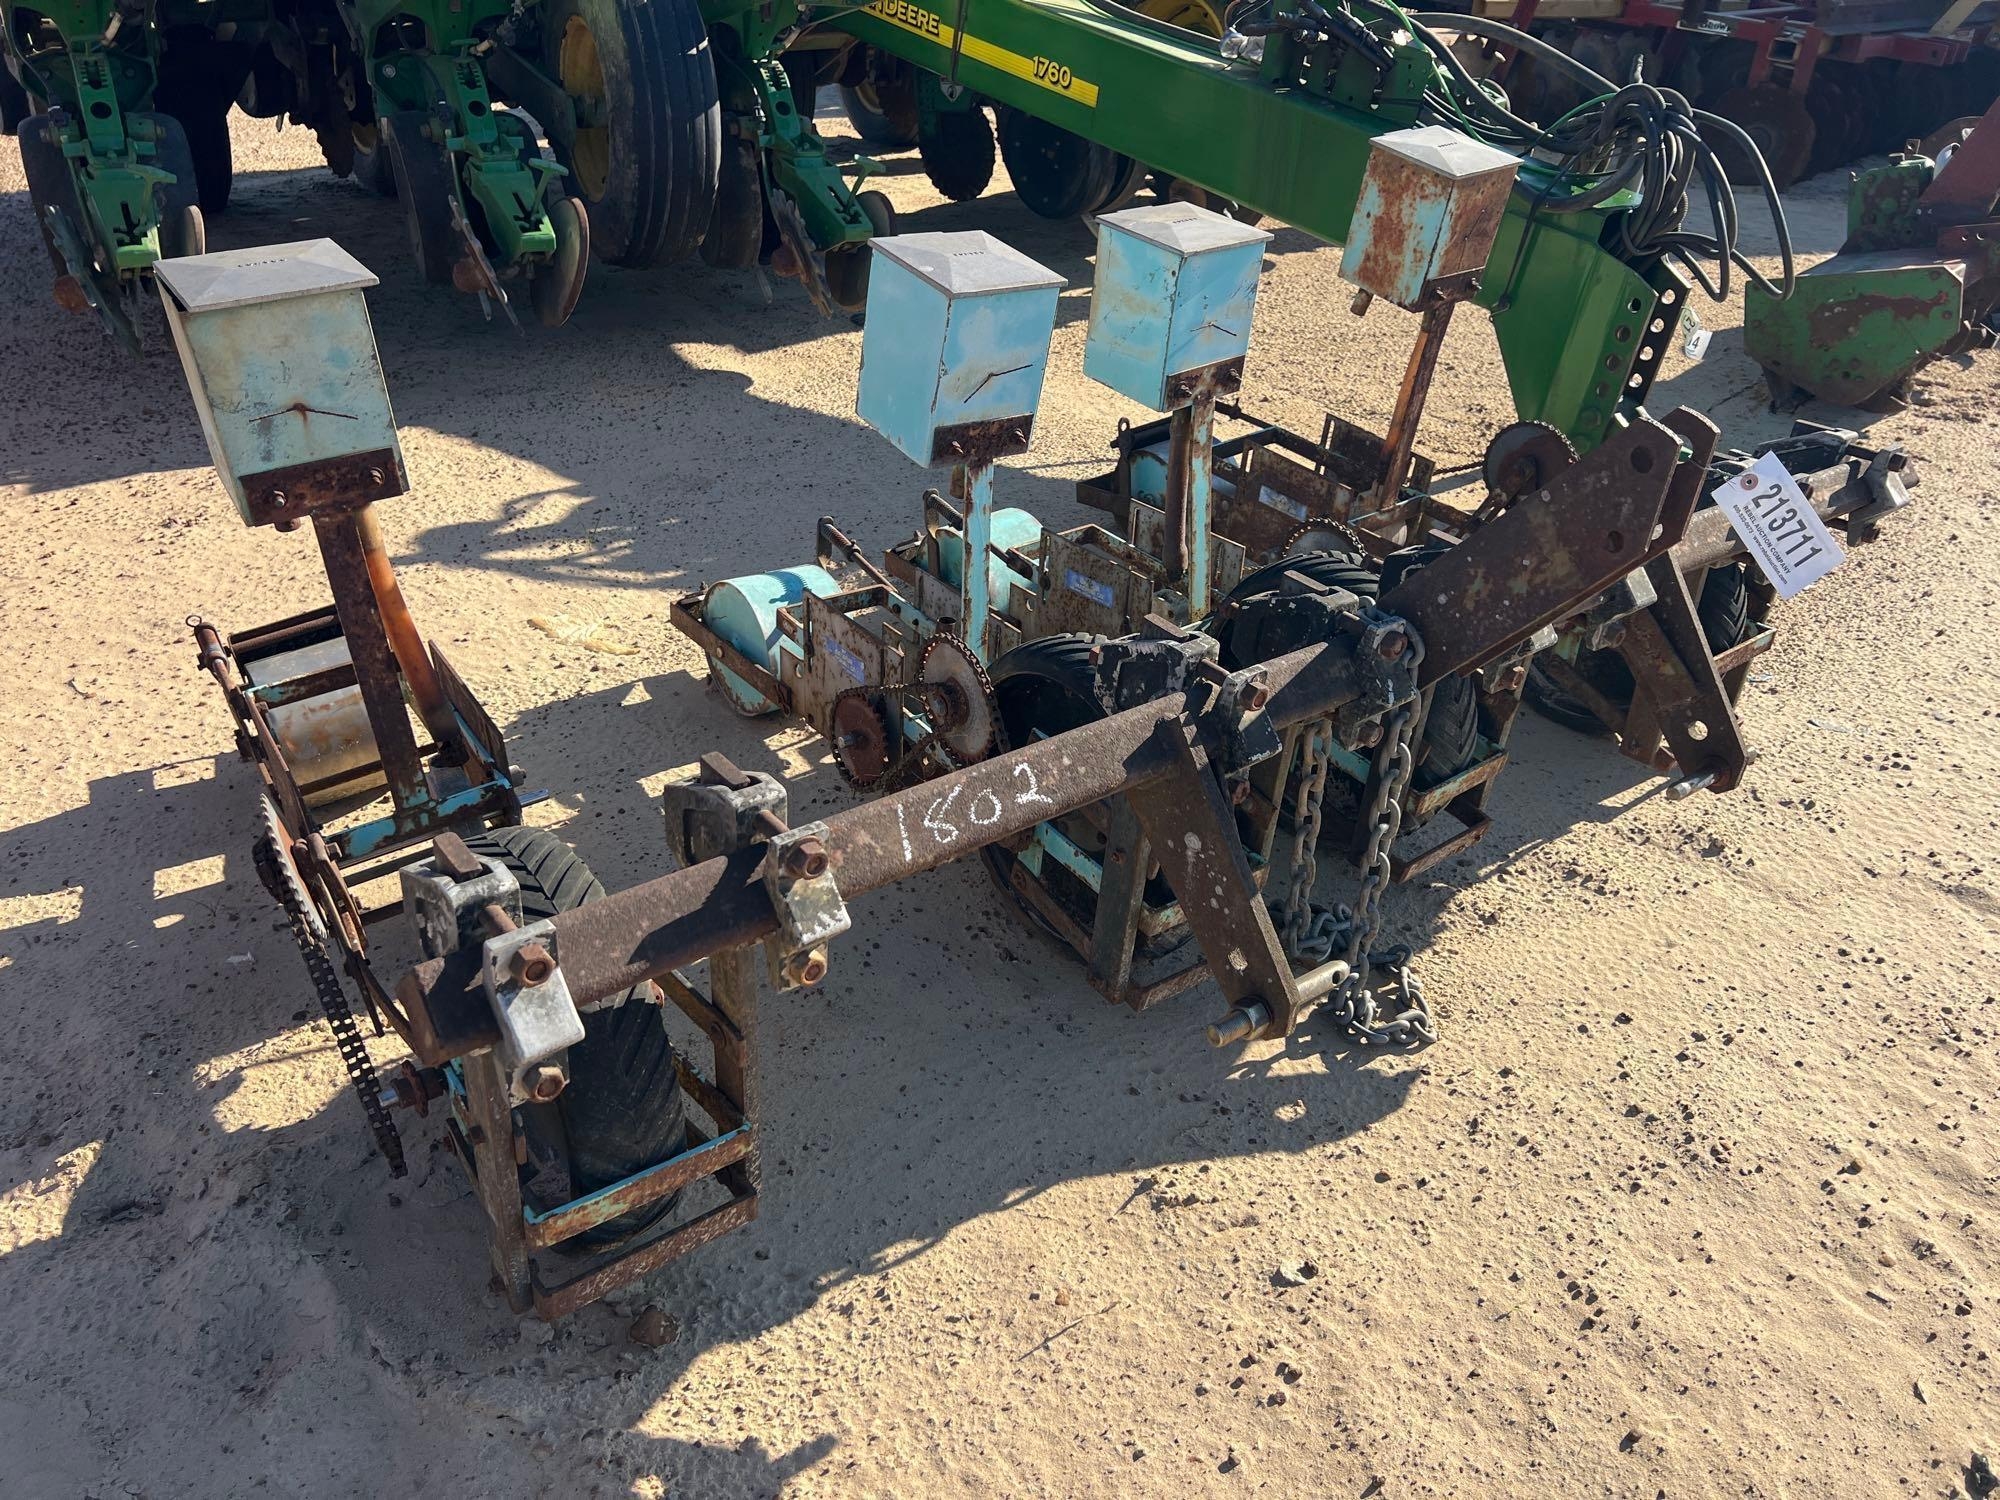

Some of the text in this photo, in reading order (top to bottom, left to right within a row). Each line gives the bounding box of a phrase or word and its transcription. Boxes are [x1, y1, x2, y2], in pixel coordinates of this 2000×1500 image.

[1032, 55, 1072, 89] 1760
[1743, 505, 1792, 574] REBEL AUCTION COMPANY
[1751, 483, 1823, 568] 213711
